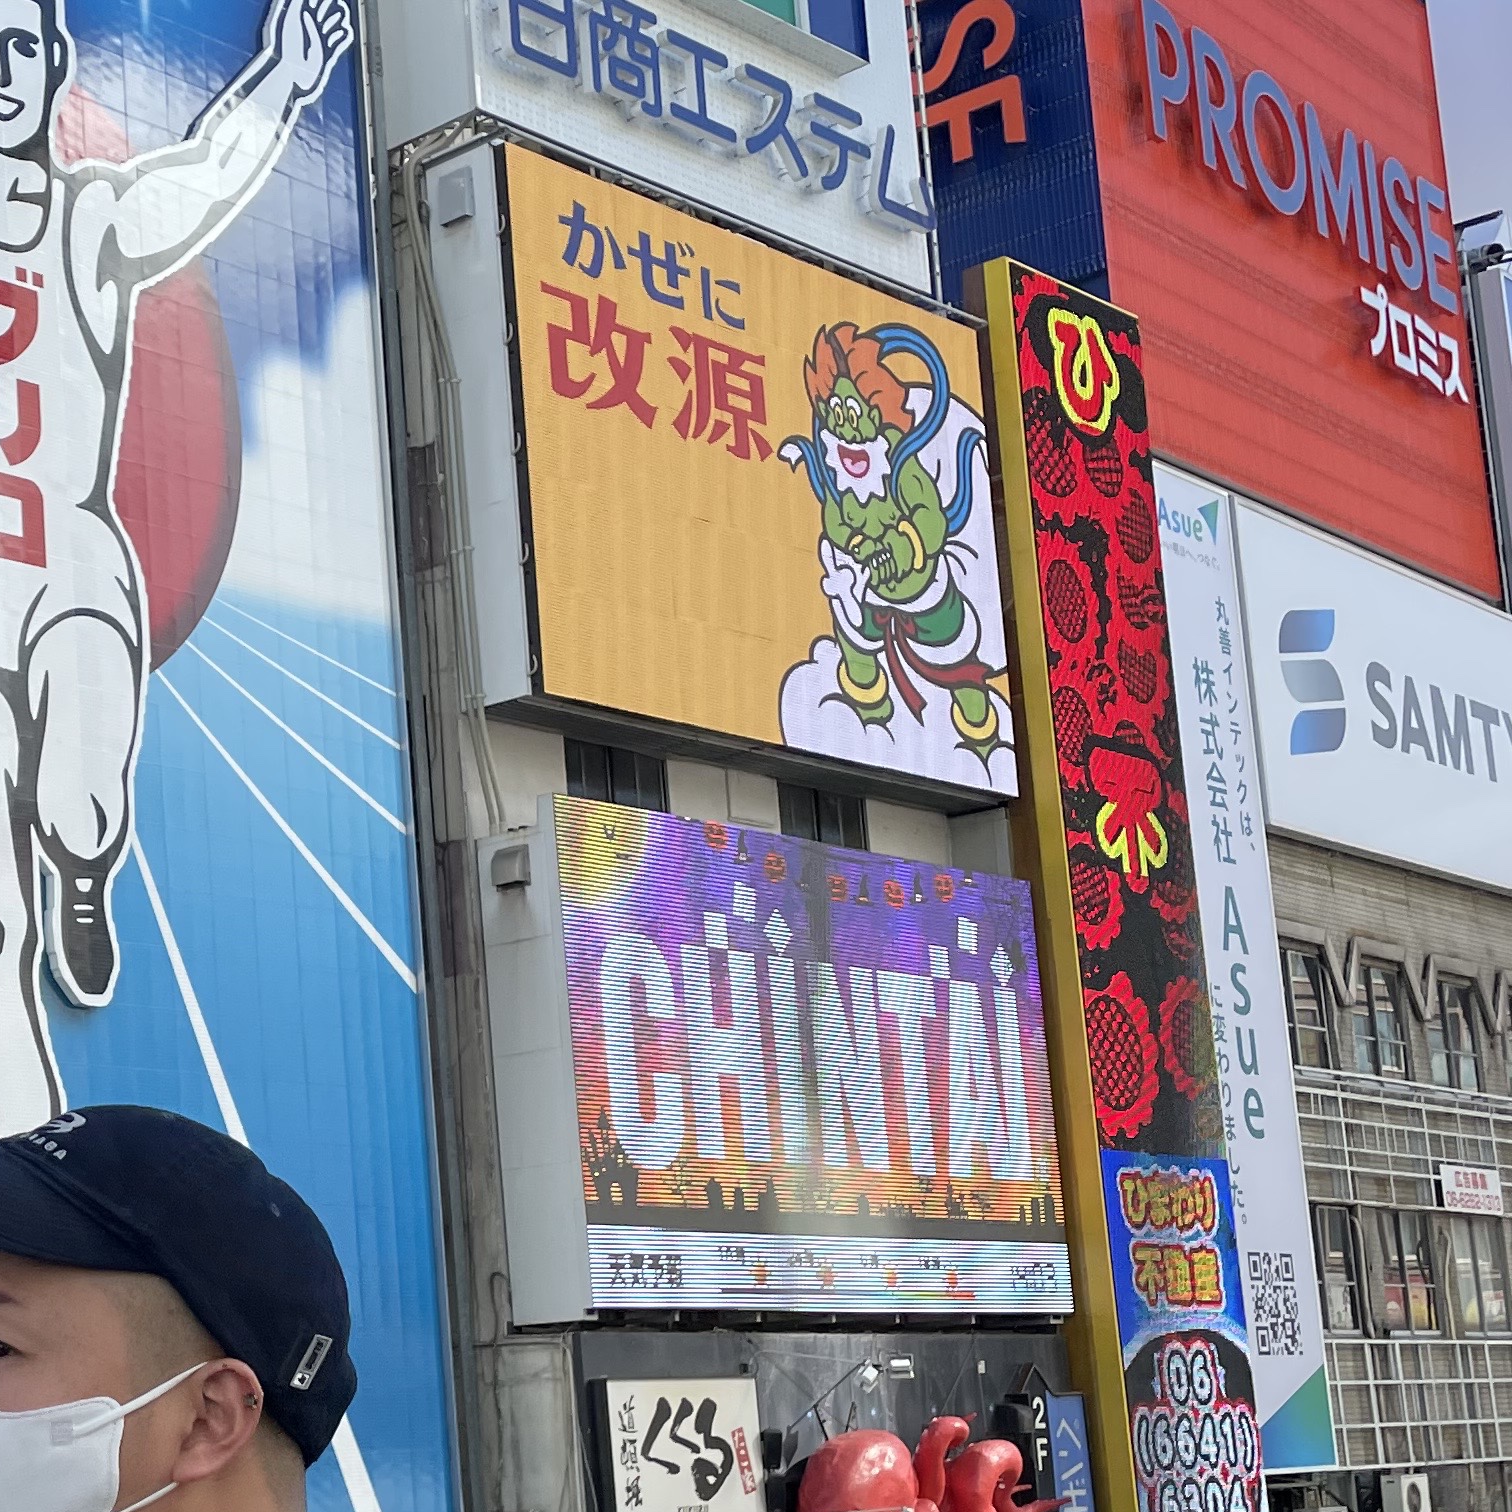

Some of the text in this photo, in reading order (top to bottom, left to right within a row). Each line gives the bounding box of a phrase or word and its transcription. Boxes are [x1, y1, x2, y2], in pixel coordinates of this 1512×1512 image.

[509, 0, 938, 231] 日商エステム
[1141, 0, 1458, 315] PROMISE
[558, 200, 746, 330] かぜに
[540, 281, 773, 461] 改源
[1360, 284, 1469, 404] プロミス
[1158, 497, 1203, 542] Asue
[1214, 595, 1256, 853] 丸善インテックは、
[1192, 656, 1265, 1140] 株式会社 Asue
[598, 928, 1034, 1182] CHINTAI
[1209, 984, 1248, 1225] に変わりました。
[1119, 1171, 1217, 1234] ひまわり
[1032, 1396, 1048, 1472] 2F
[1166, 1350, 1215, 1406] 06
[641, 1396, 734, 1502] くくる
[1137, 1411, 1255, 1477] (6641)
